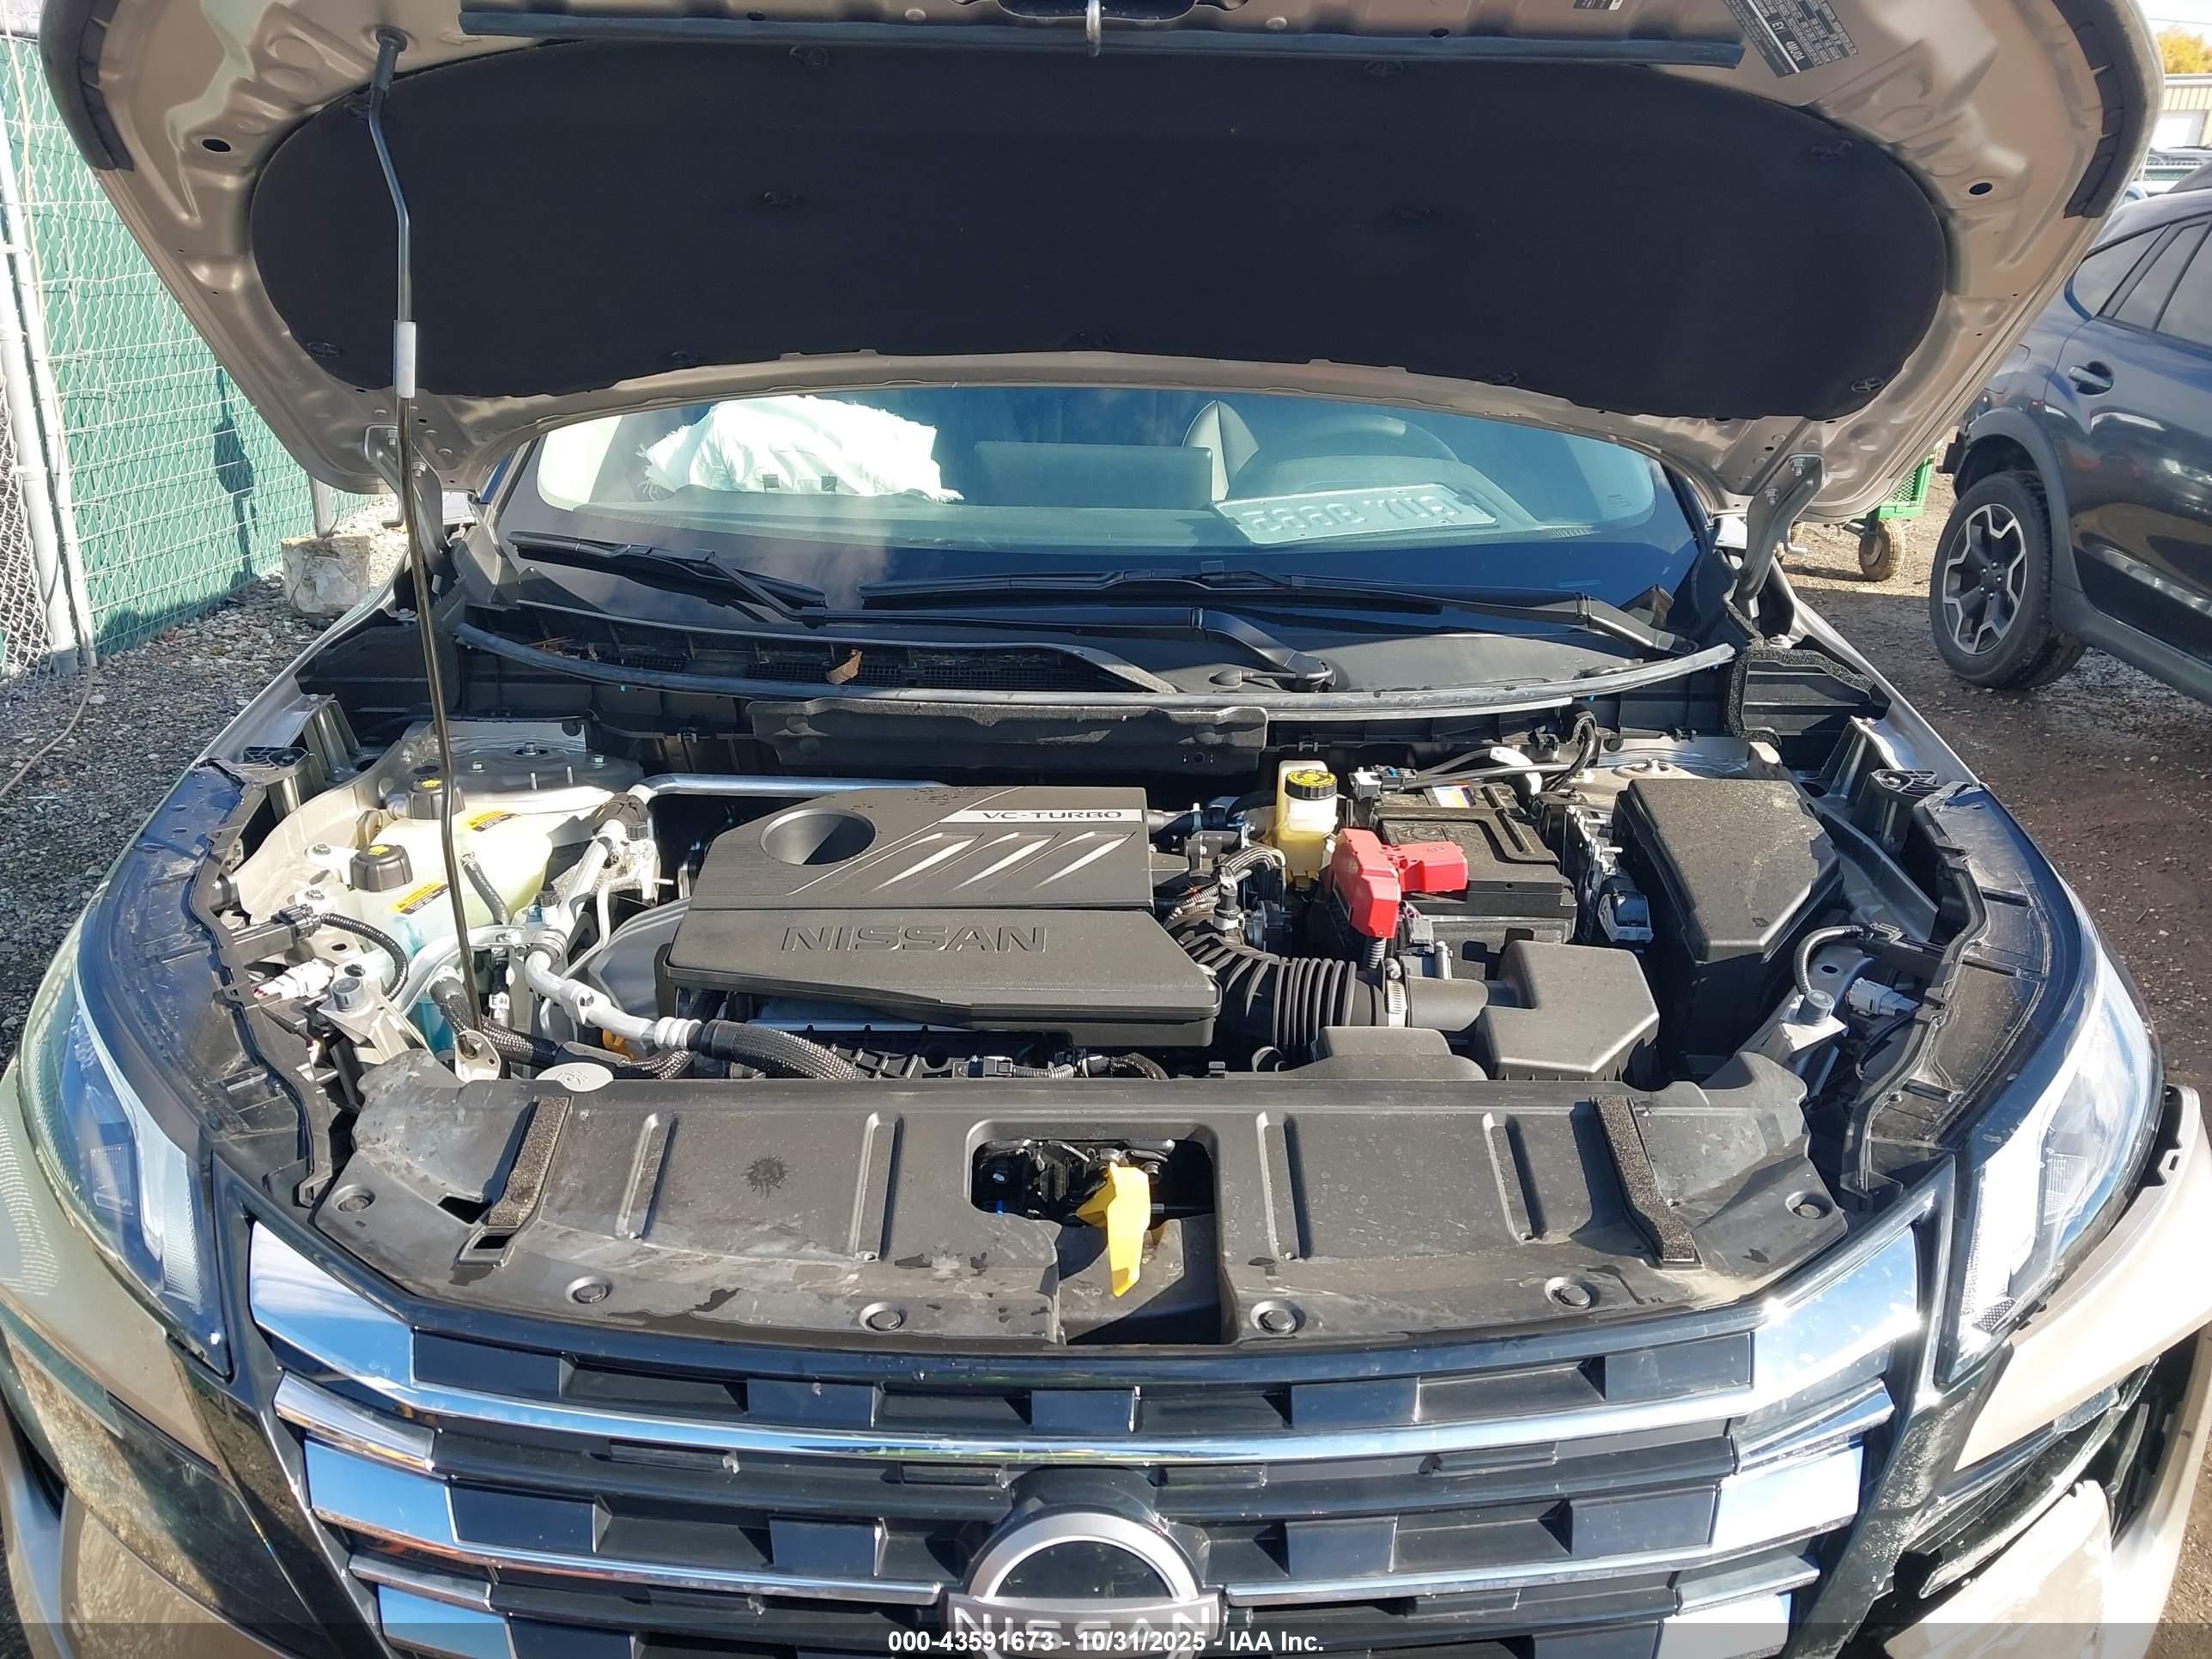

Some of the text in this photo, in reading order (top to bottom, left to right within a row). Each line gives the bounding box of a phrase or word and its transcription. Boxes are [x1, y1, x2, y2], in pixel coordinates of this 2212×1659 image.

[981, 810, 1123, 820] VC-TURBO
[781, 926, 1048, 952] NISSAN
[952, 1607, 1211, 1651] NISSAN
